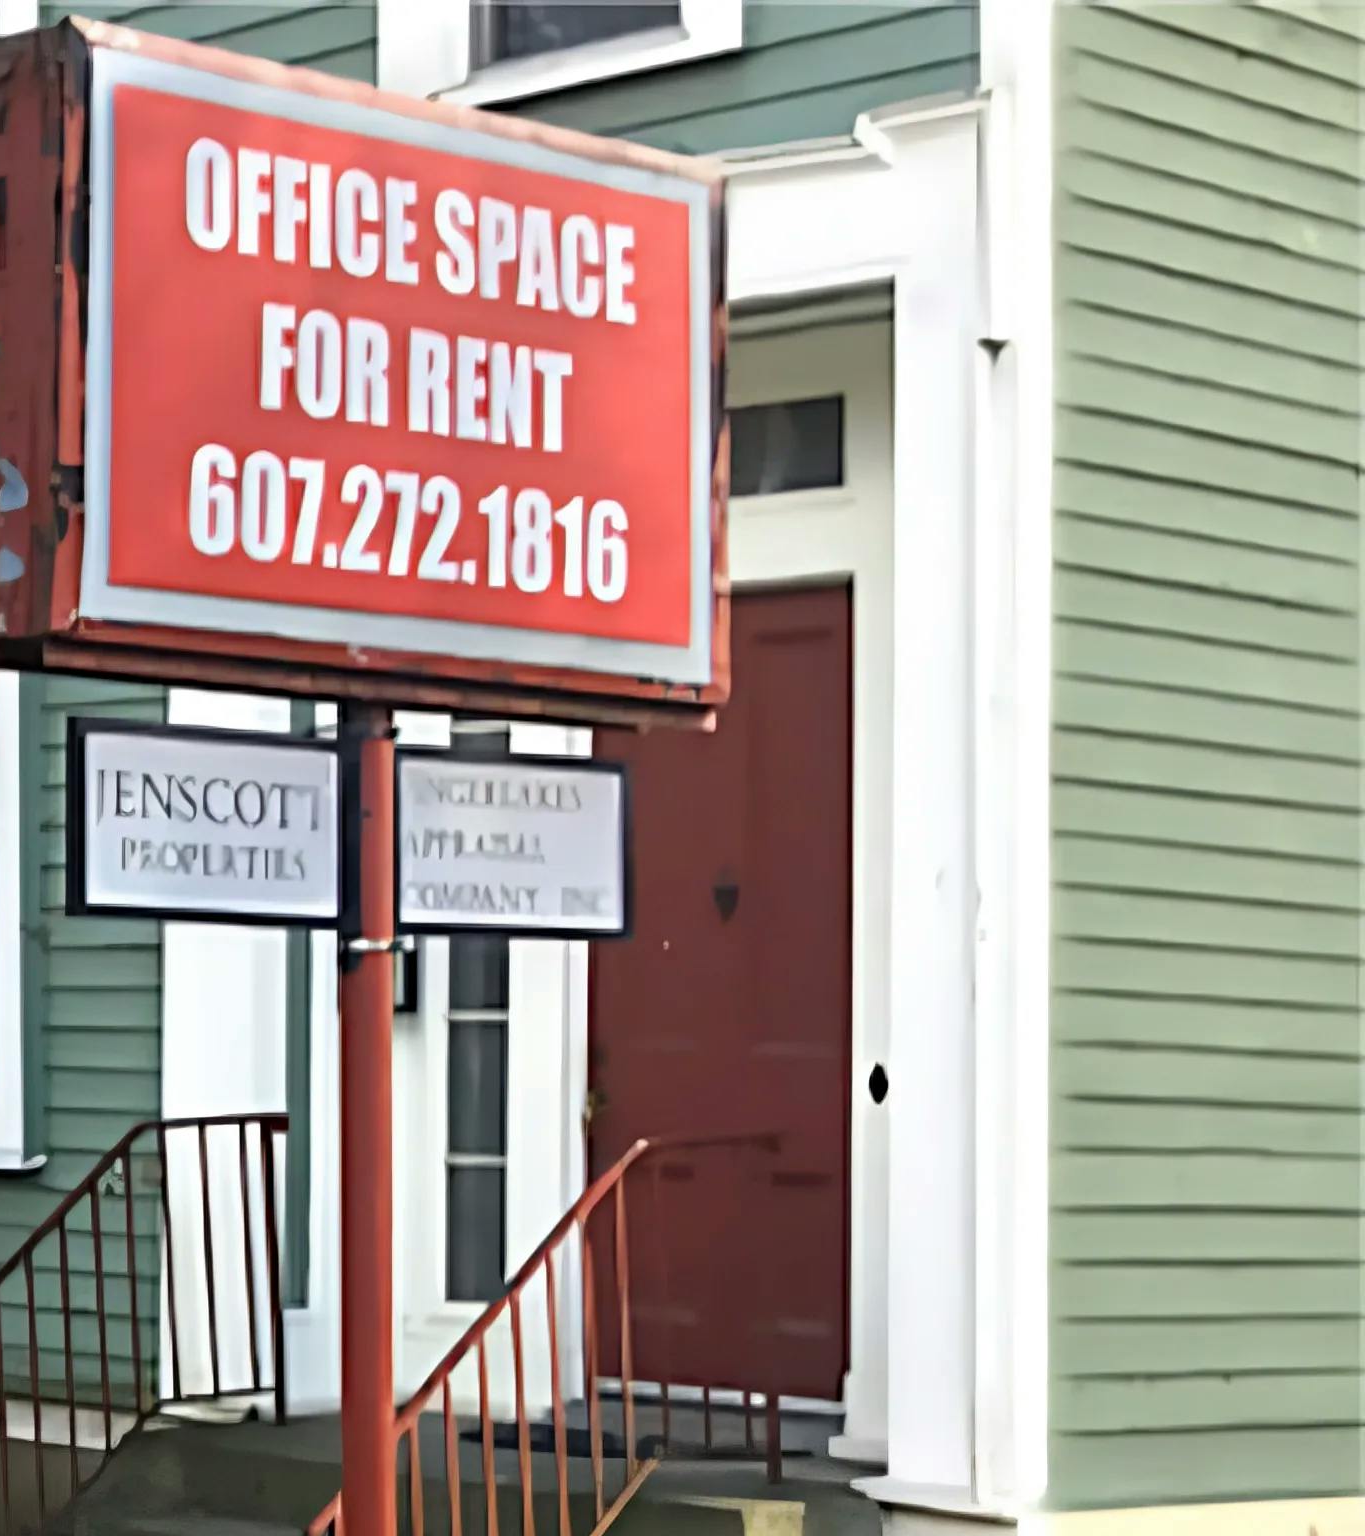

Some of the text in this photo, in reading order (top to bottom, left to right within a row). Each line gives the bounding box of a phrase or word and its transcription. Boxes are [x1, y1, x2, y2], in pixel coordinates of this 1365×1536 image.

[185, 138, 636, 326] OFFICE SPACE
[260, 302, 572, 453] FOR RENT
[189, 444, 629, 603] 607.272.1816
[96, 768, 323, 832] JENSCOTT
[120, 836, 307, 881] PROPERTIES
